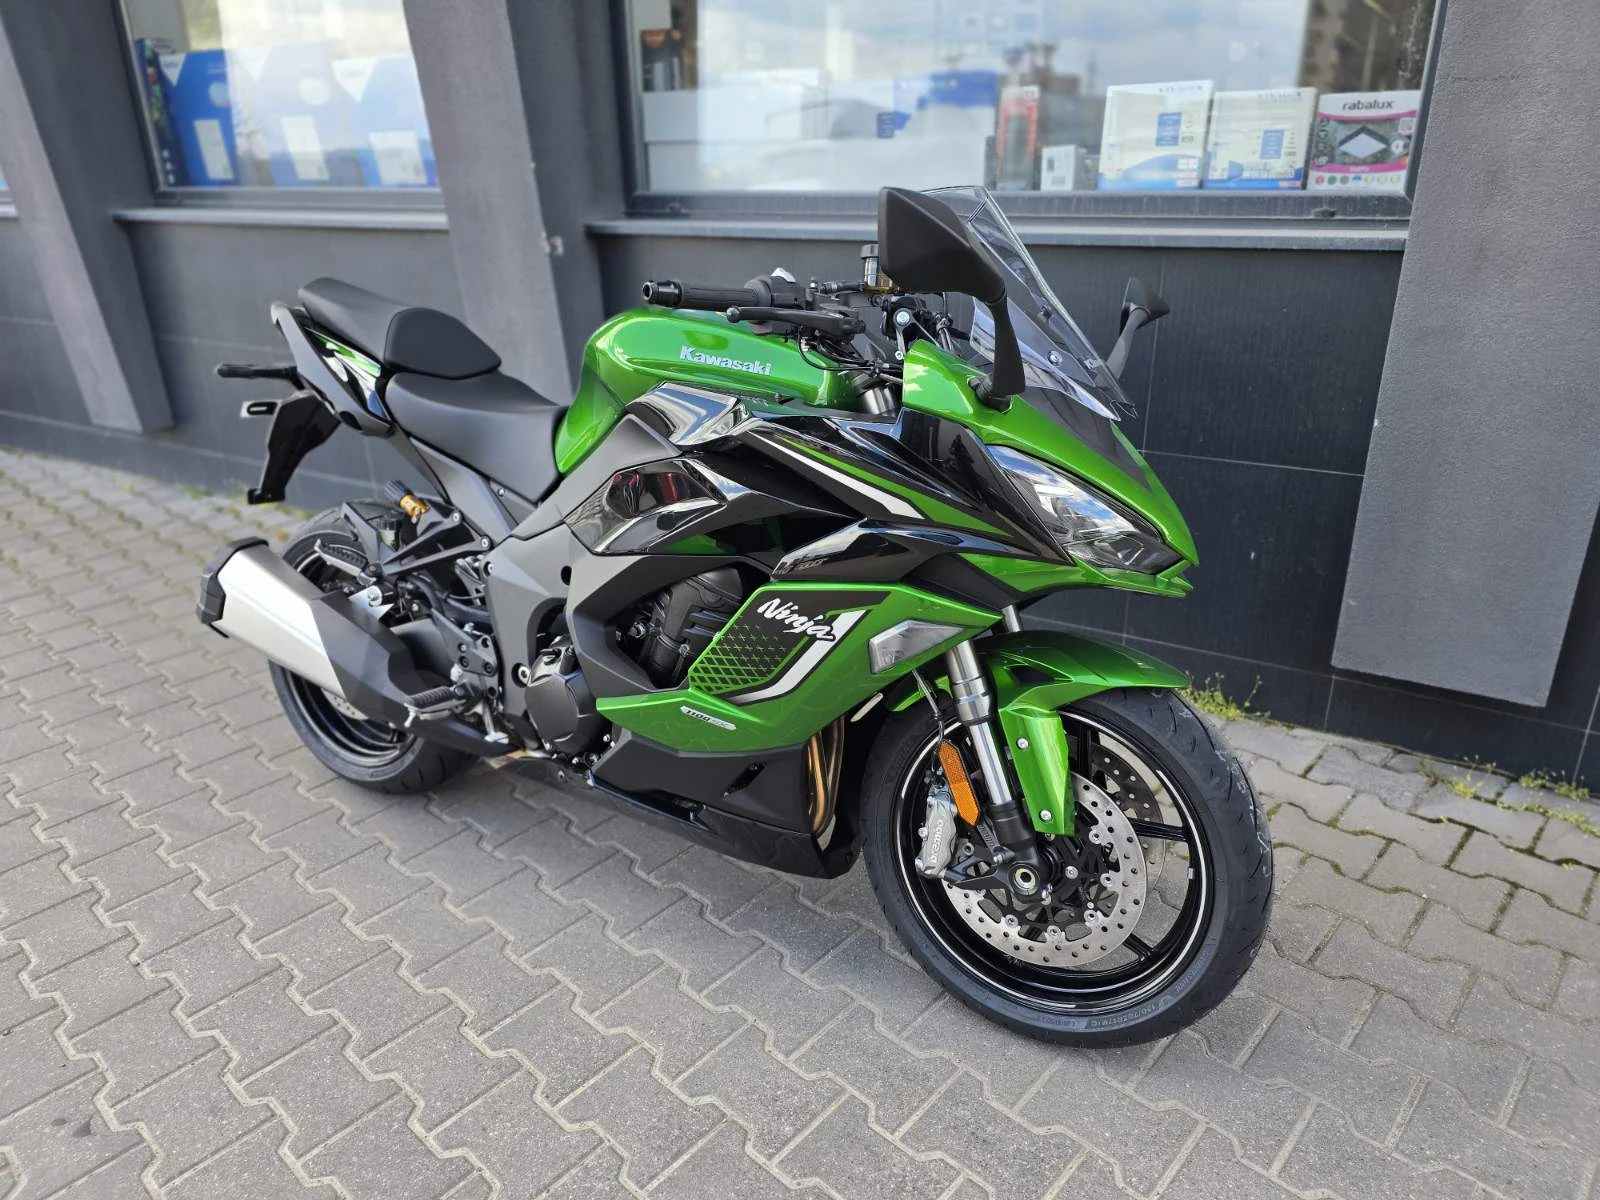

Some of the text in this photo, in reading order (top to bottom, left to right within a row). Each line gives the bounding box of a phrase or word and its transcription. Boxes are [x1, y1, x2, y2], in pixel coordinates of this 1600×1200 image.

[1342, 100, 1393, 111] rabalux
[680, 345, 772, 376] Kawasaki
[757, 598, 834, 640] Ninja
[928, 819, 944, 863] brembo
